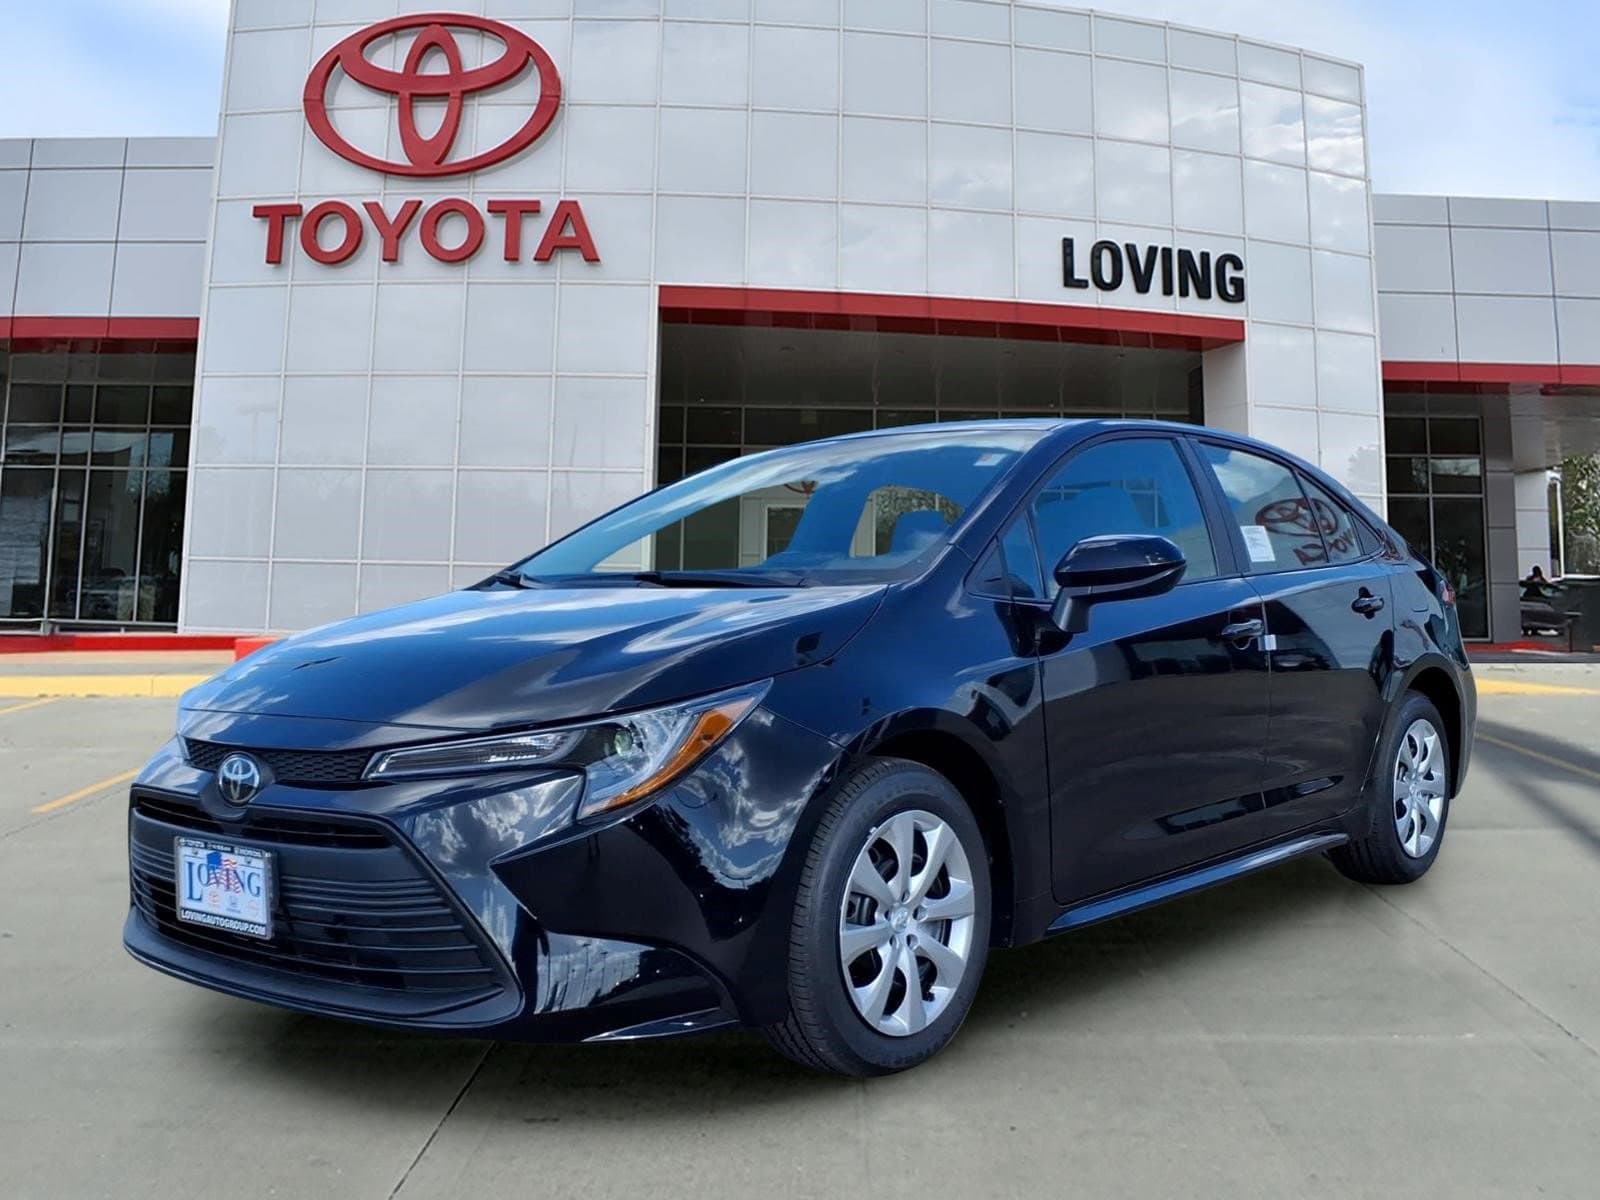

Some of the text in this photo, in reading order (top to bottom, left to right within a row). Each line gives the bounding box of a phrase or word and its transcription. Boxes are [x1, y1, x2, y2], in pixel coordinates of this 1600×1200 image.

[252, 198, 601, 266] TOYOTA
[1062, 237, 1246, 303] LOVING
[184, 860, 262, 903] LOVING
[181, 909, 266, 936] LOVINGAUTOGROUP.COM
